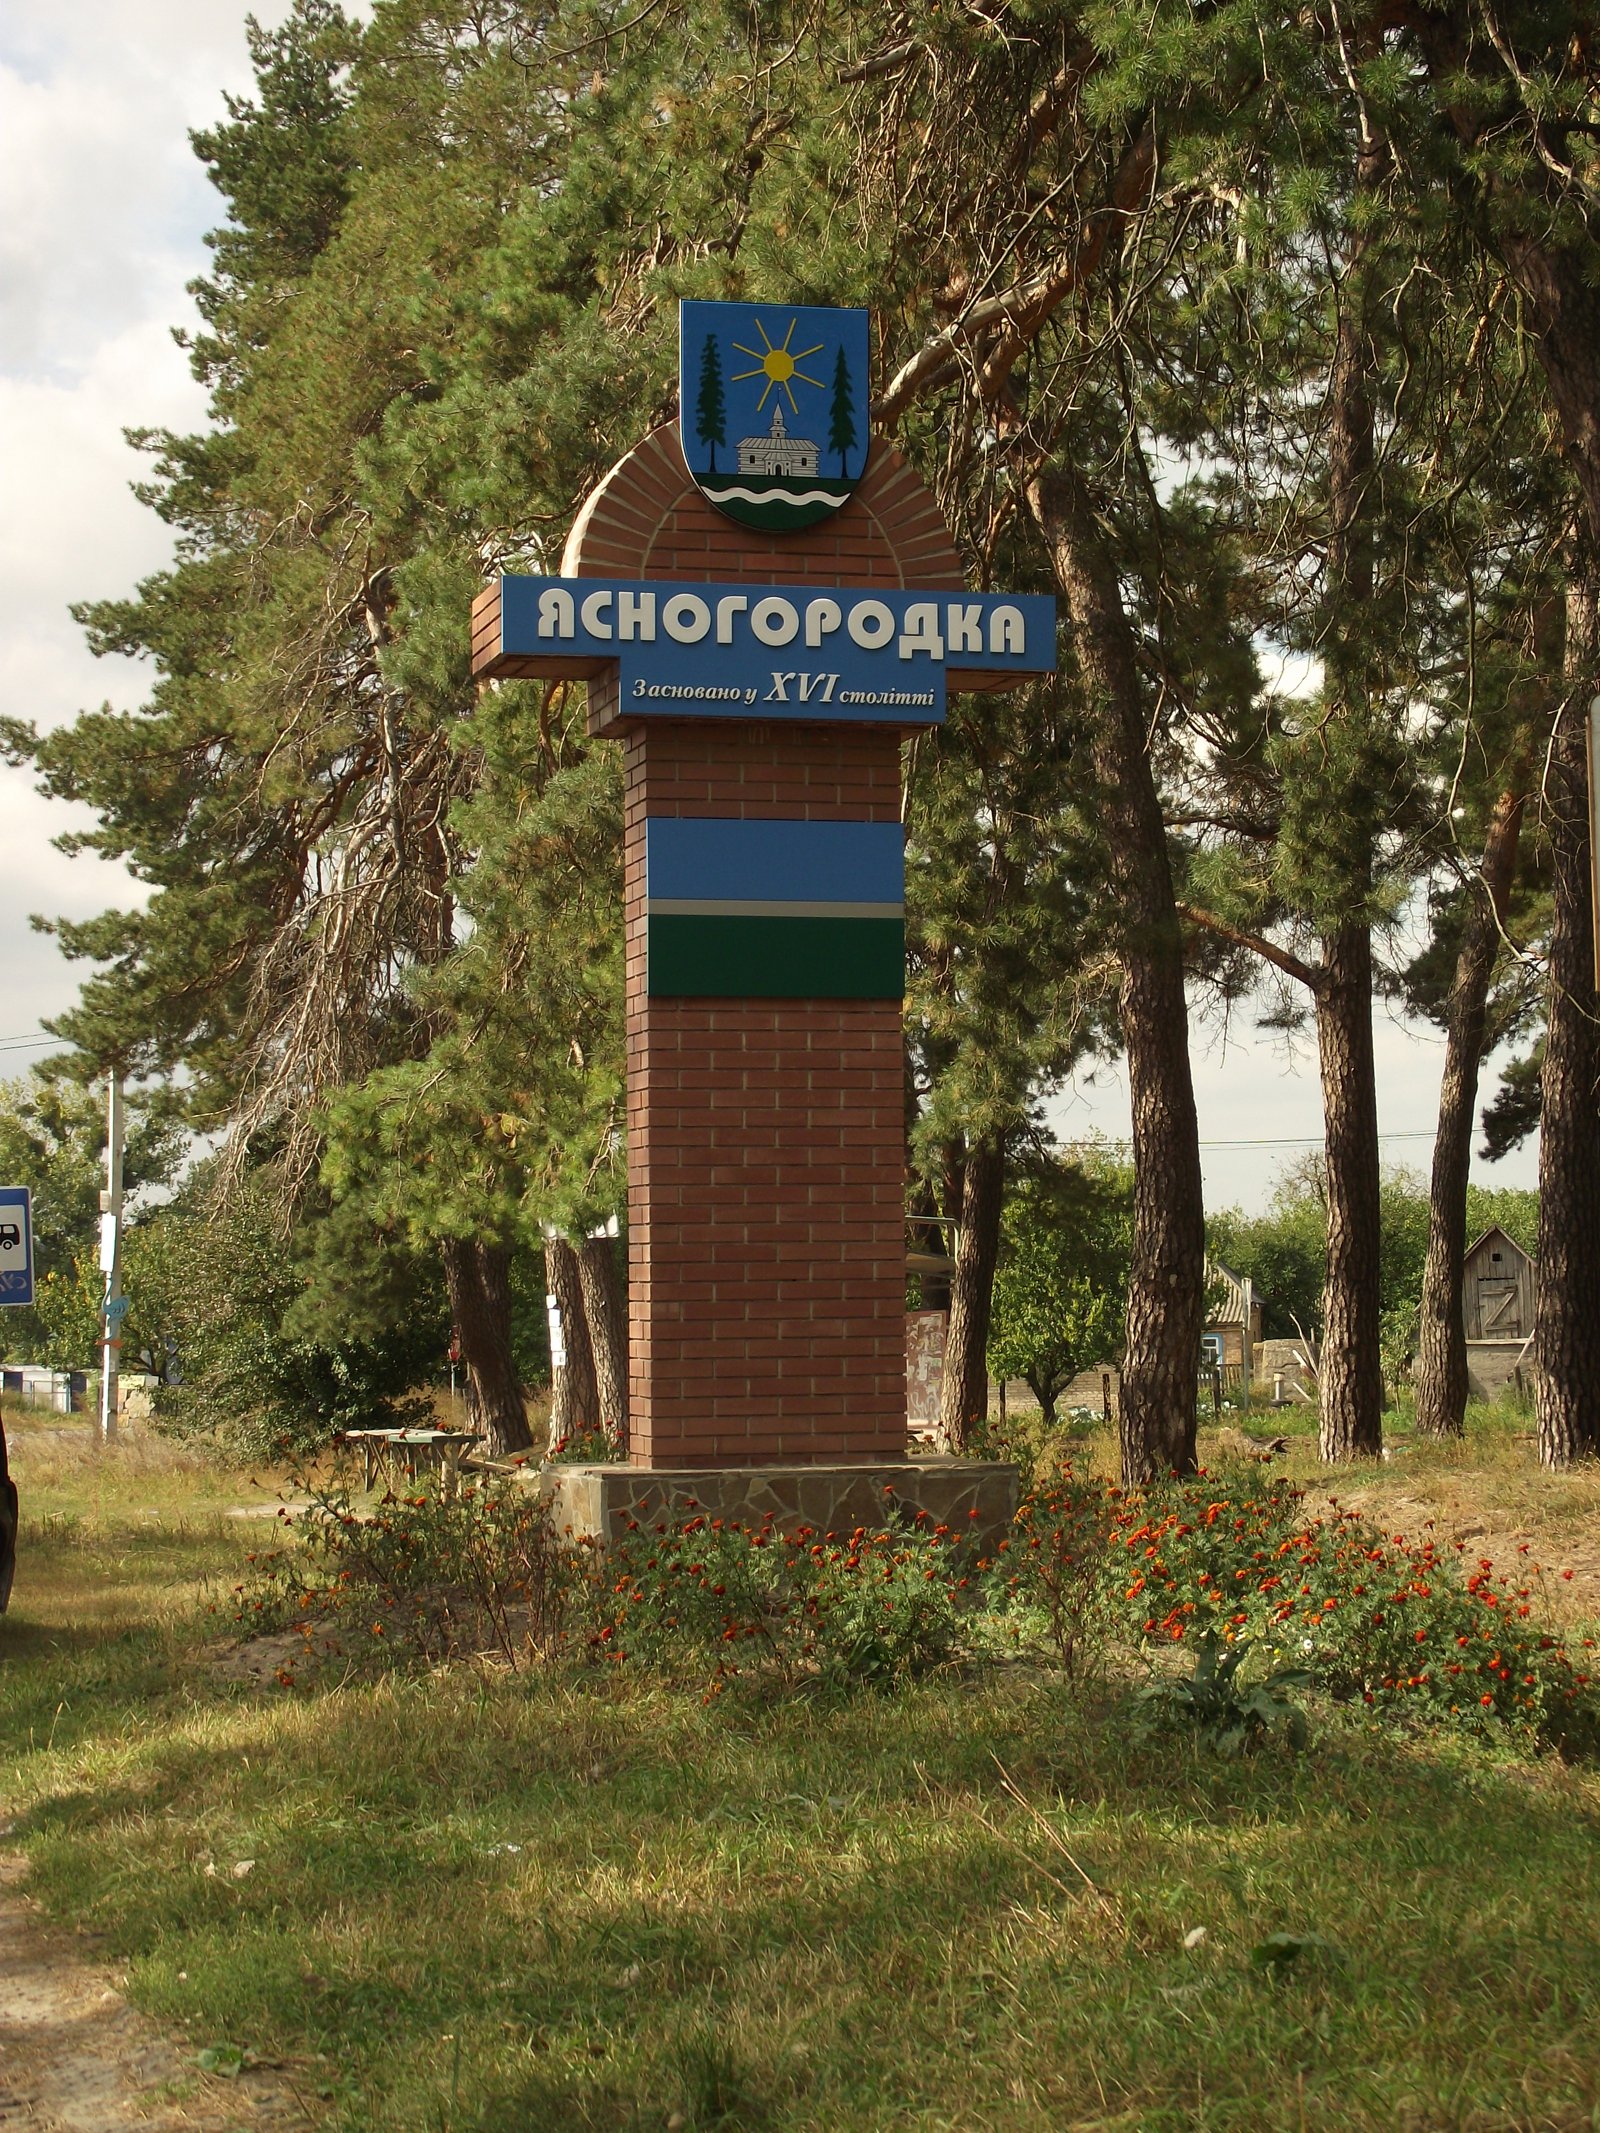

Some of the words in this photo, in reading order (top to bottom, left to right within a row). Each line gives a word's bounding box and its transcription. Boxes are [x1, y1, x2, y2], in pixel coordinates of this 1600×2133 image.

[537, 587, 1026, 660] ЯСНОГОРОДКА
[632, 679, 741, 700] Засновано
[743, 687, 758, 705] у
[763, 672, 841, 703] XVI
[839, 687, 935, 706] столітті
